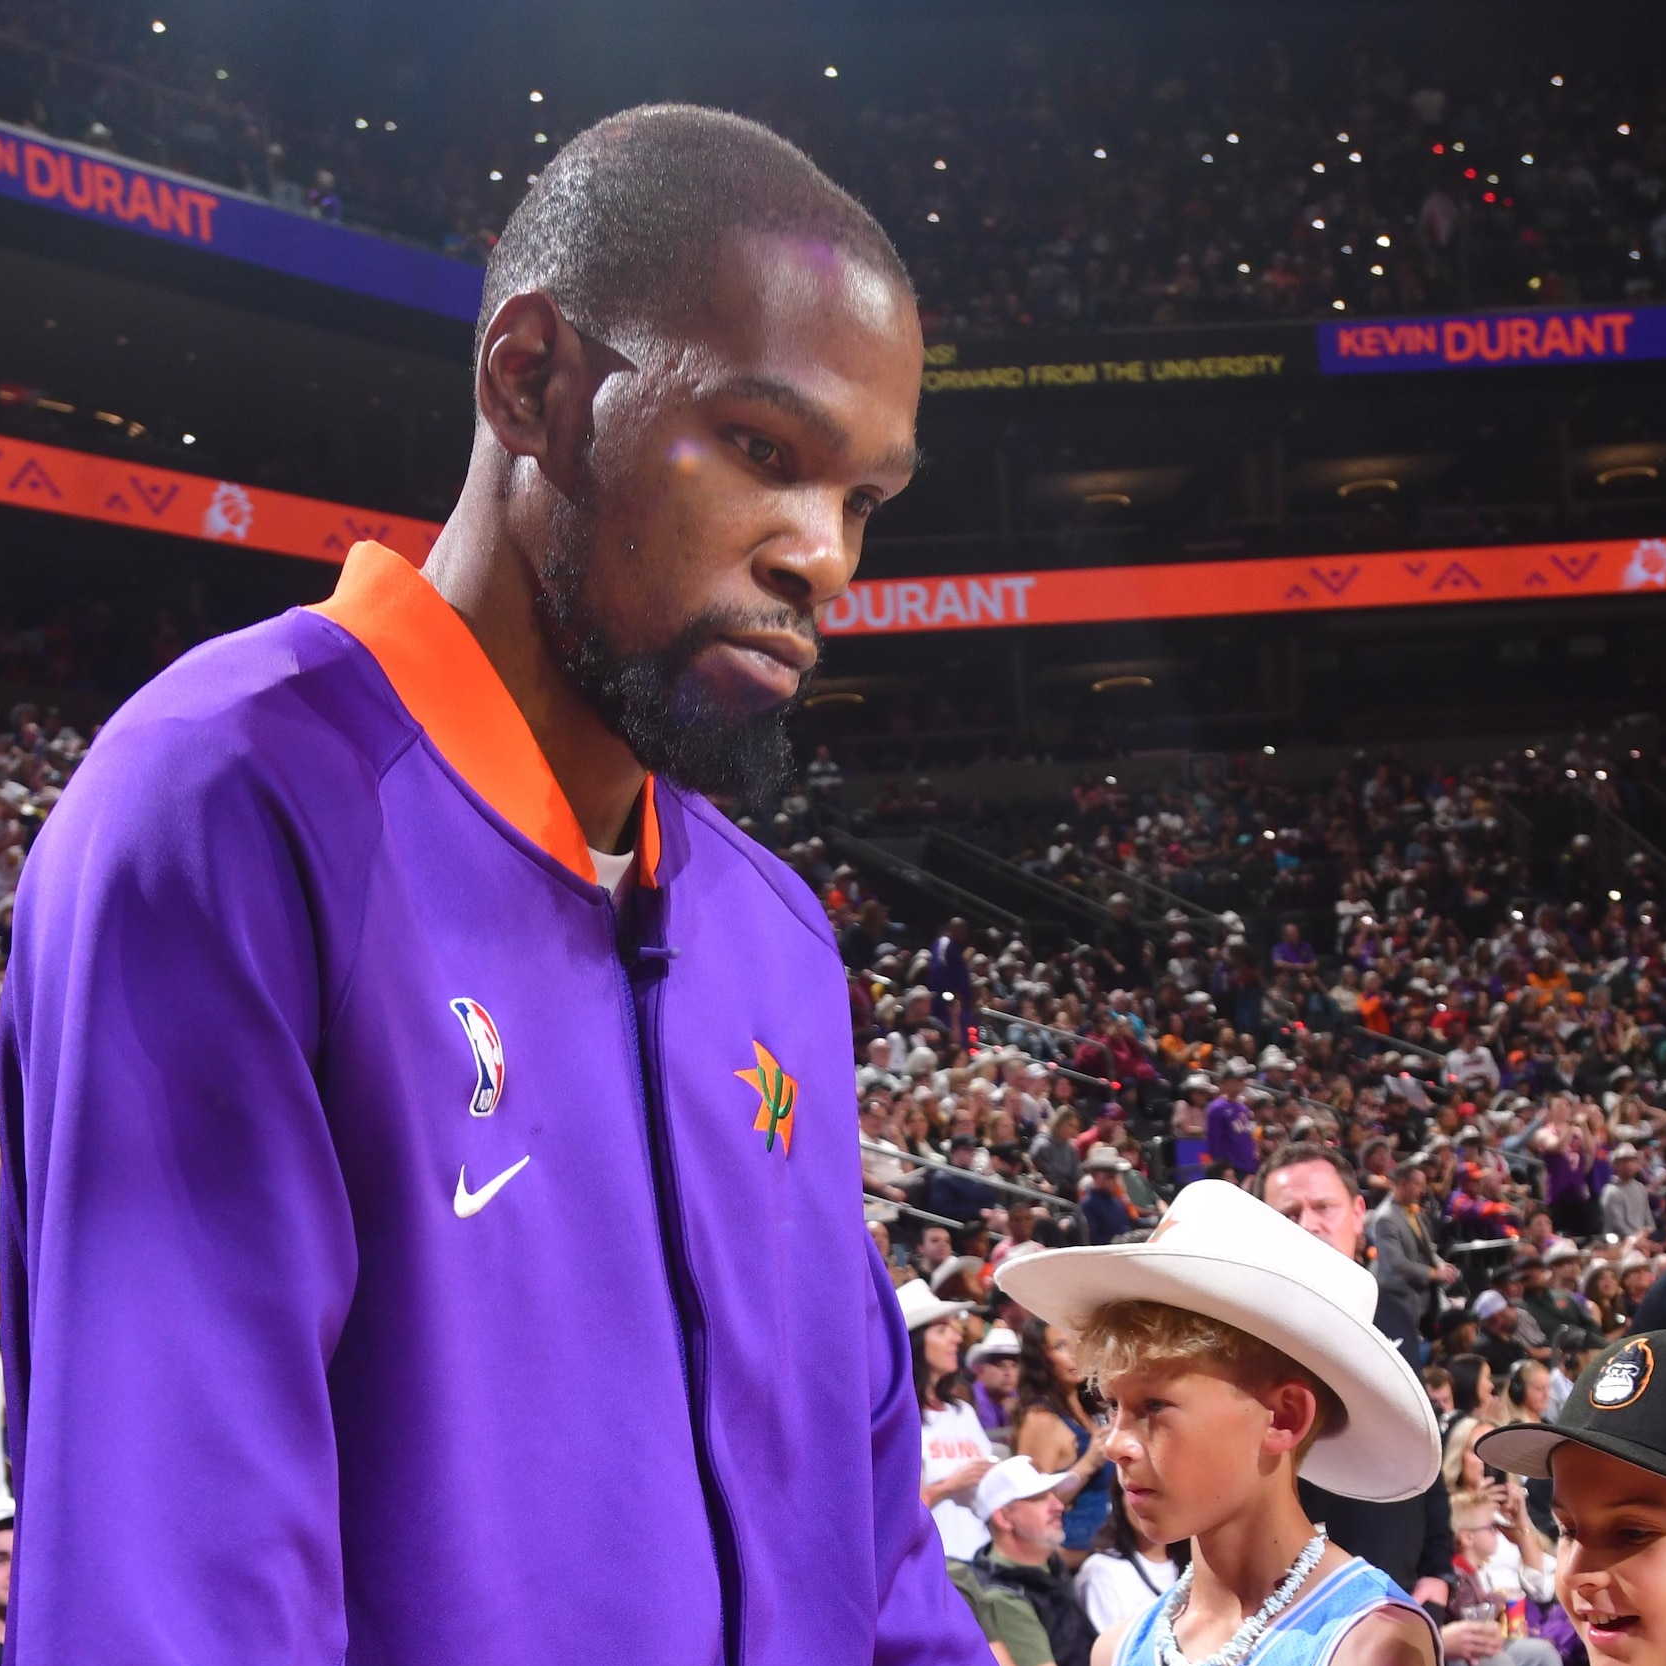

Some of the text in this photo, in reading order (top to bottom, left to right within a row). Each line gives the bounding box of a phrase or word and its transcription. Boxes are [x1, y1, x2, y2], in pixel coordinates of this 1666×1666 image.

[24, 143, 219, 243] DURANT
[1337, 312, 1634, 363] KEVIN DURANT
[924, 354, 1285, 391] ORWARD FROM THE UNIVERSITY
[825, 576, 1037, 629] DURANT
